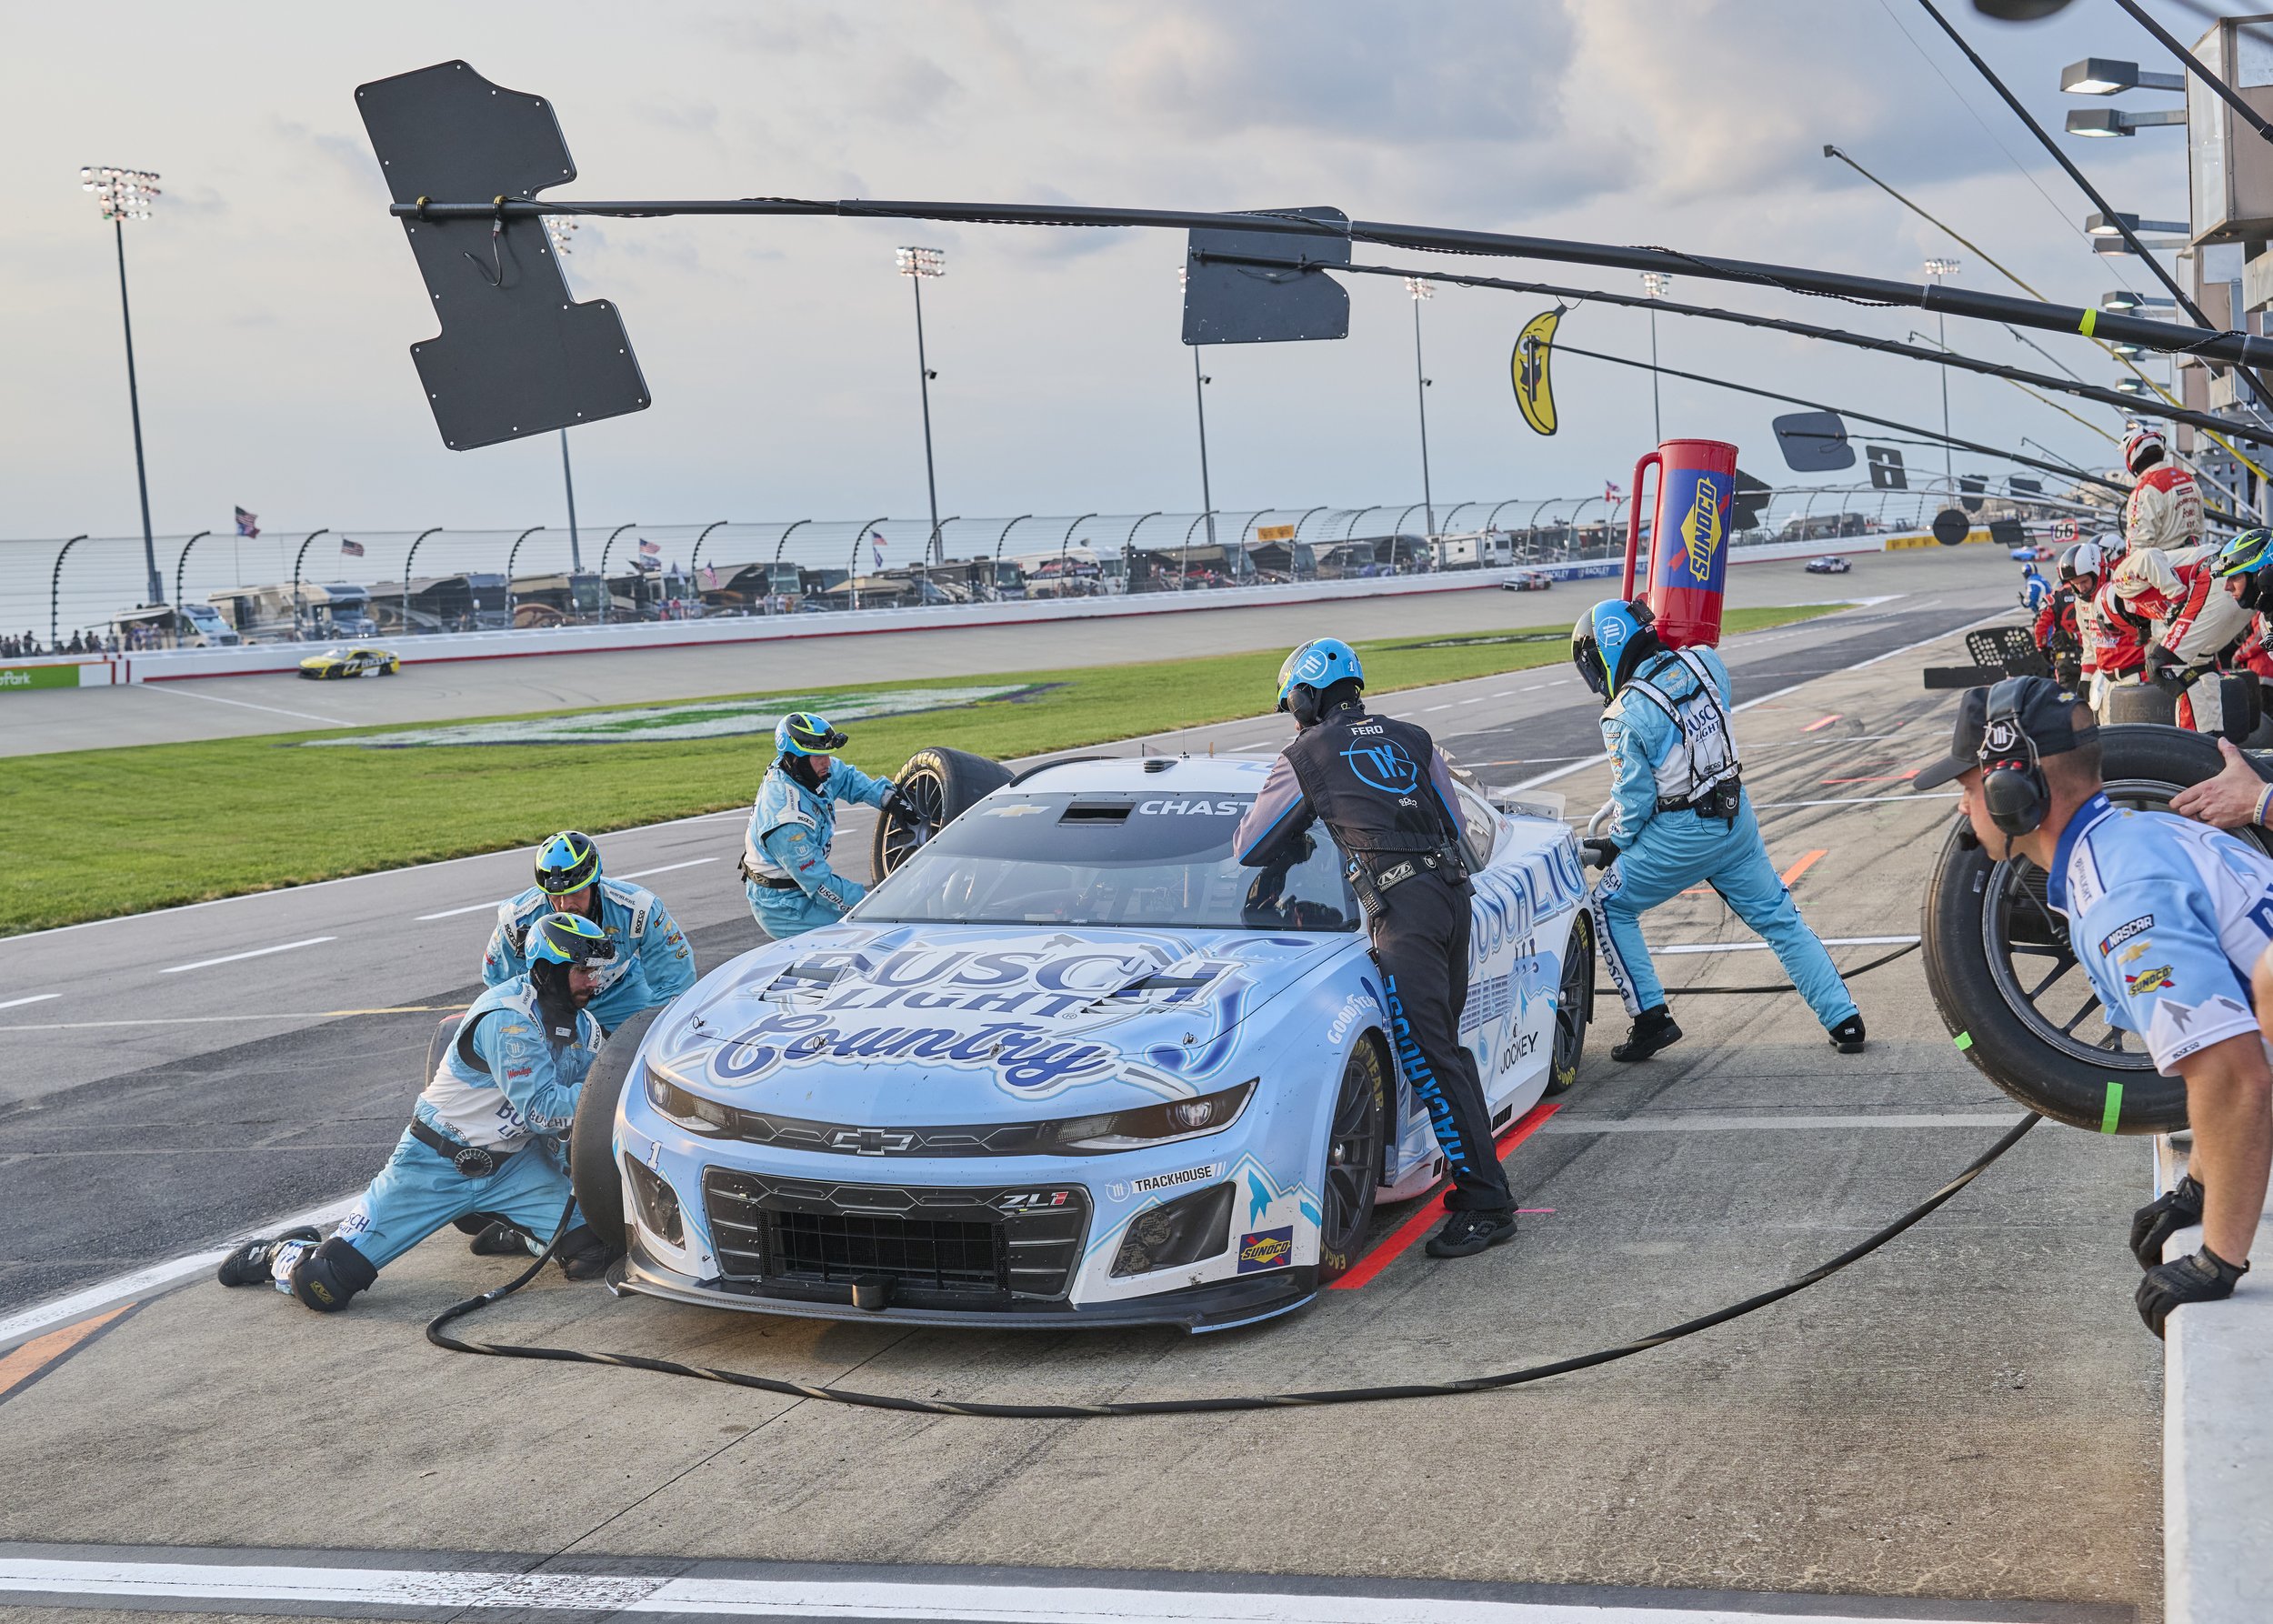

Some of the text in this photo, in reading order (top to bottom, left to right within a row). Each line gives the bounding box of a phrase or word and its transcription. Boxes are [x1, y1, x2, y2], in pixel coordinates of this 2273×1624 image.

[1693, 481, 1716, 576] SUNOCO
[1348, 661, 1355, 671] 1
[1695, 720, 1720, 743] LIGHT
[1138, 800, 1255, 816] CHAST
[2108, 915, 2153, 947] NASCAR
[2130, 967, 2169, 996] SUNOCO
[817, 987, 1093, 1018] LIGHT
[714, 1013, 1119, 1089] Country
[1500, 1031, 1538, 1075] JOCKEY
[444, 1121, 466, 1141] sparco
[646, 1140, 663, 1171] 1
[1136, 1165, 1212, 1192] TRACKHOUSE
[998, 1191, 1069, 1208] ZL1
[1244, 1240, 1289, 1259] SUNOCO
